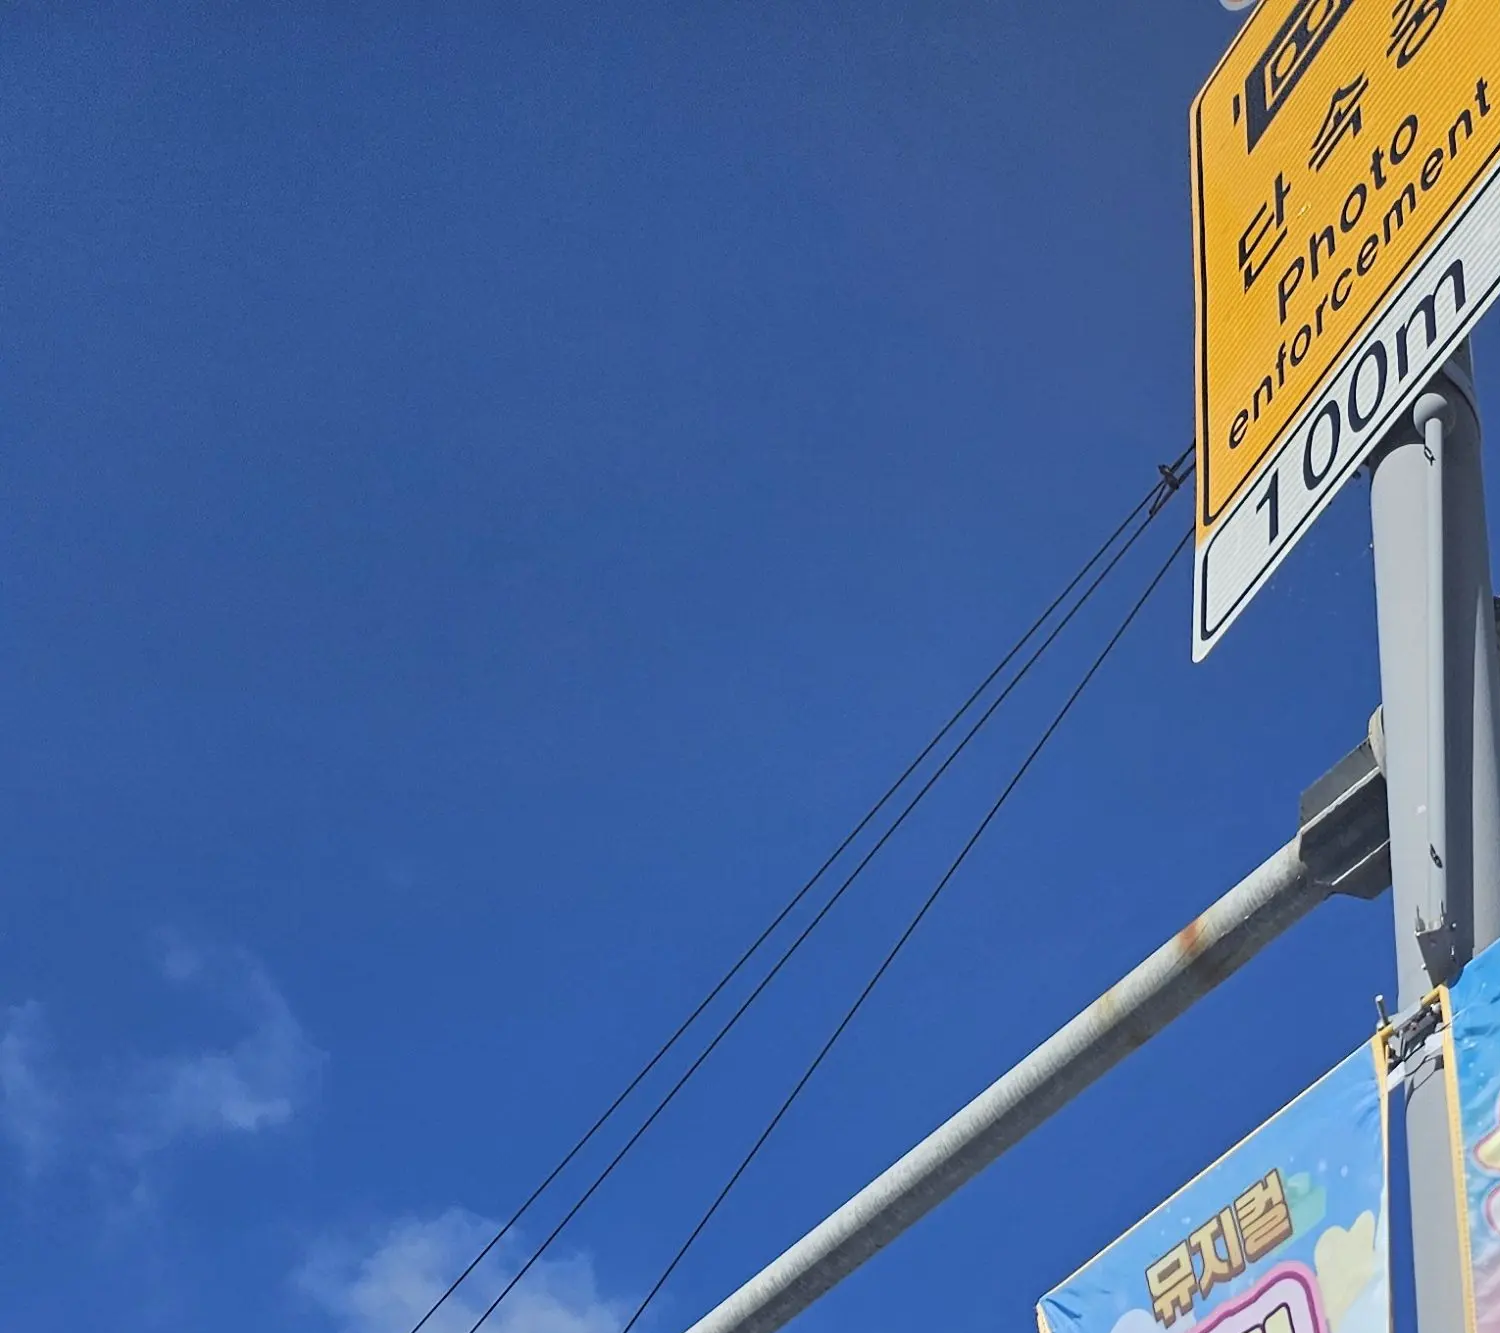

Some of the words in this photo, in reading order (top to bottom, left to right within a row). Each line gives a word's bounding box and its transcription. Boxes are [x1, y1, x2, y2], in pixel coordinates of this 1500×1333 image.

[1228, 76, 1491, 450] enforcement
[1277, 113, 1419, 325] Photo
[1255, 257, 1467, 546] 100m
[1145, 1168, 1293, 1328] 뮤지컬
